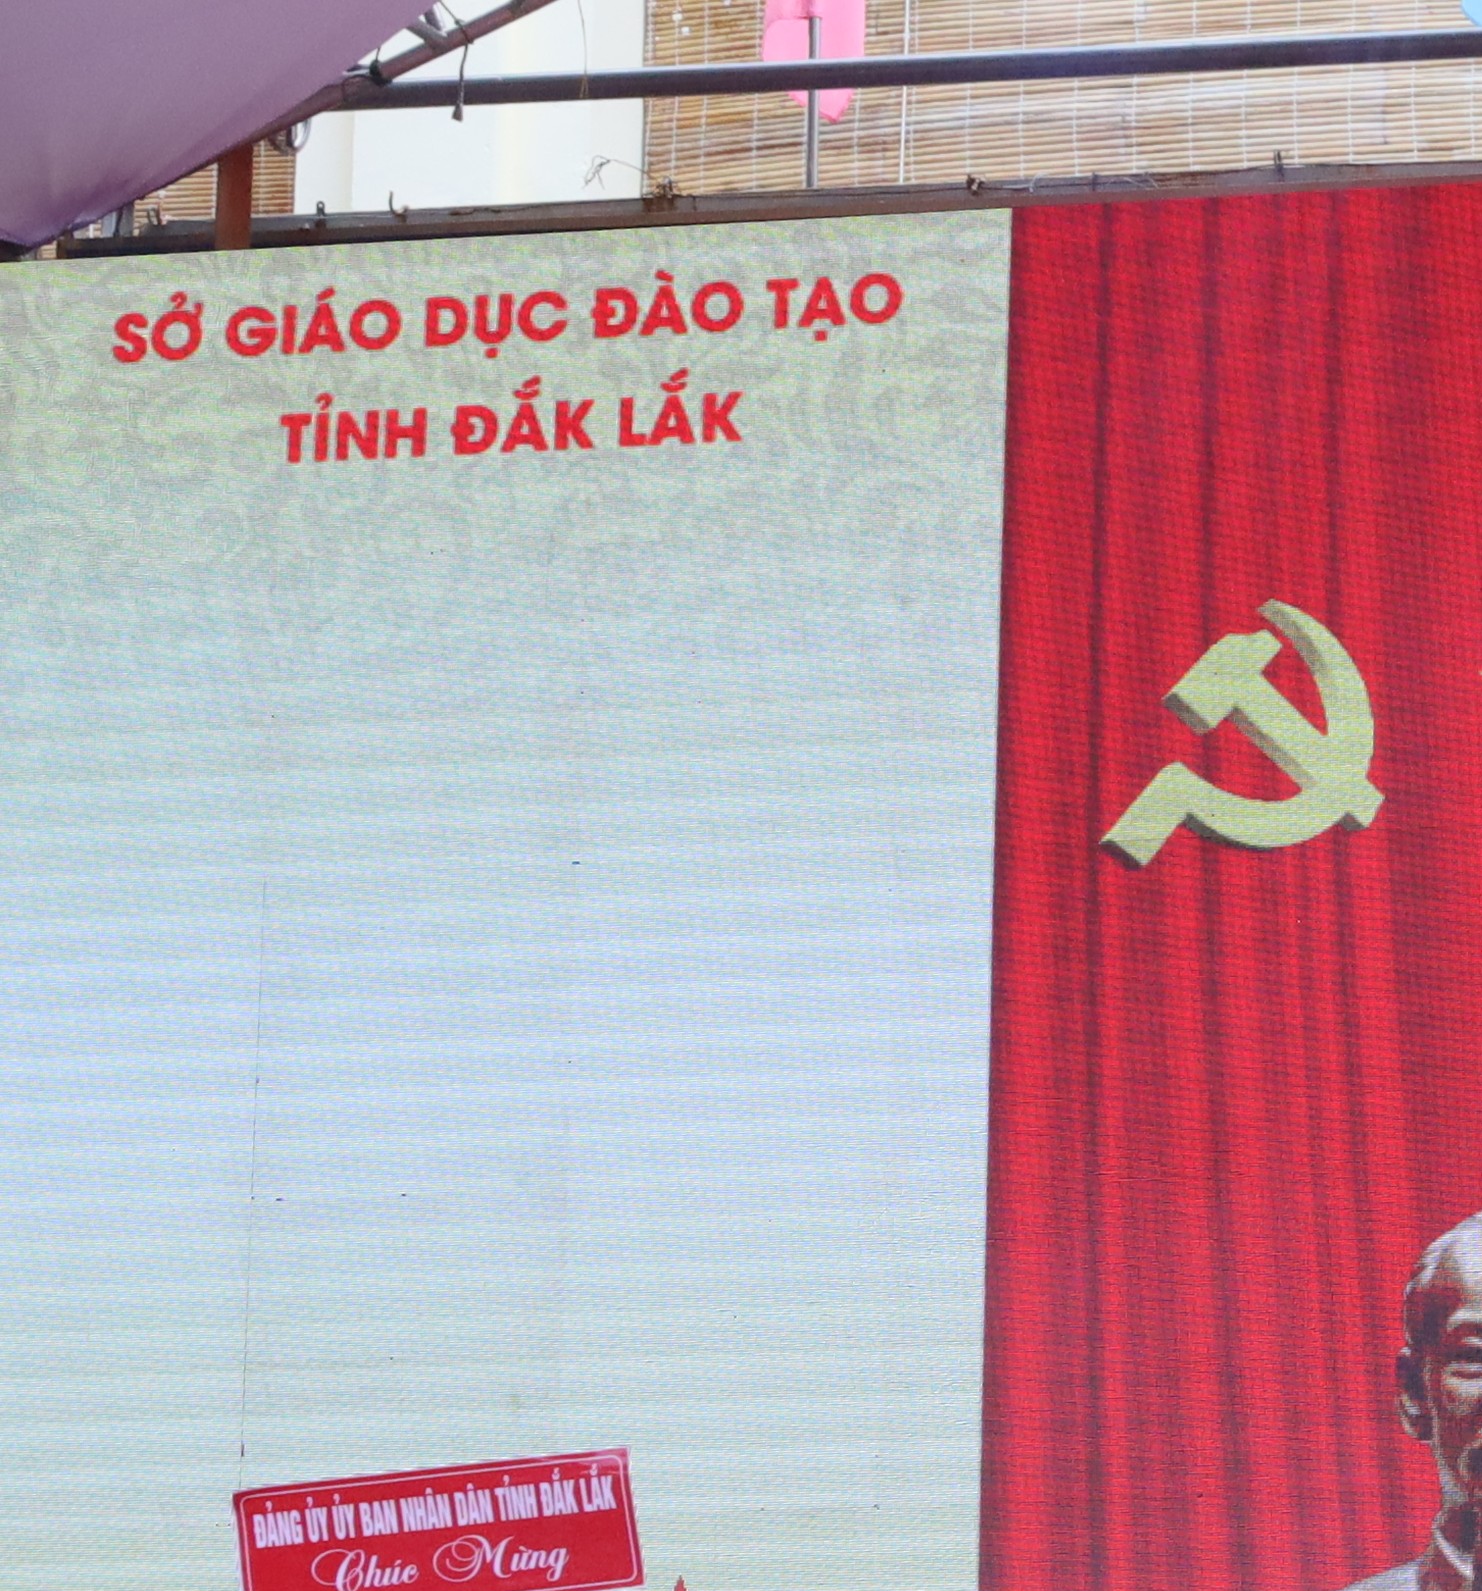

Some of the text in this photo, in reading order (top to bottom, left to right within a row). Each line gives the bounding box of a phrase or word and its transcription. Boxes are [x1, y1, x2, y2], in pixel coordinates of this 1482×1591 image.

[113, 269, 904, 363] SỞ GIÁO DỤC ĐÀO TẠO
[280, 369, 742, 464] TỈNH ĐẮK LẮK
[253, 1464, 618, 1549] ĐẢNG ỦY ỦY BAN NHÂN DÂN TỈNH ĐẮK LẮK
[432, 1534, 570, 1582] Mừng
